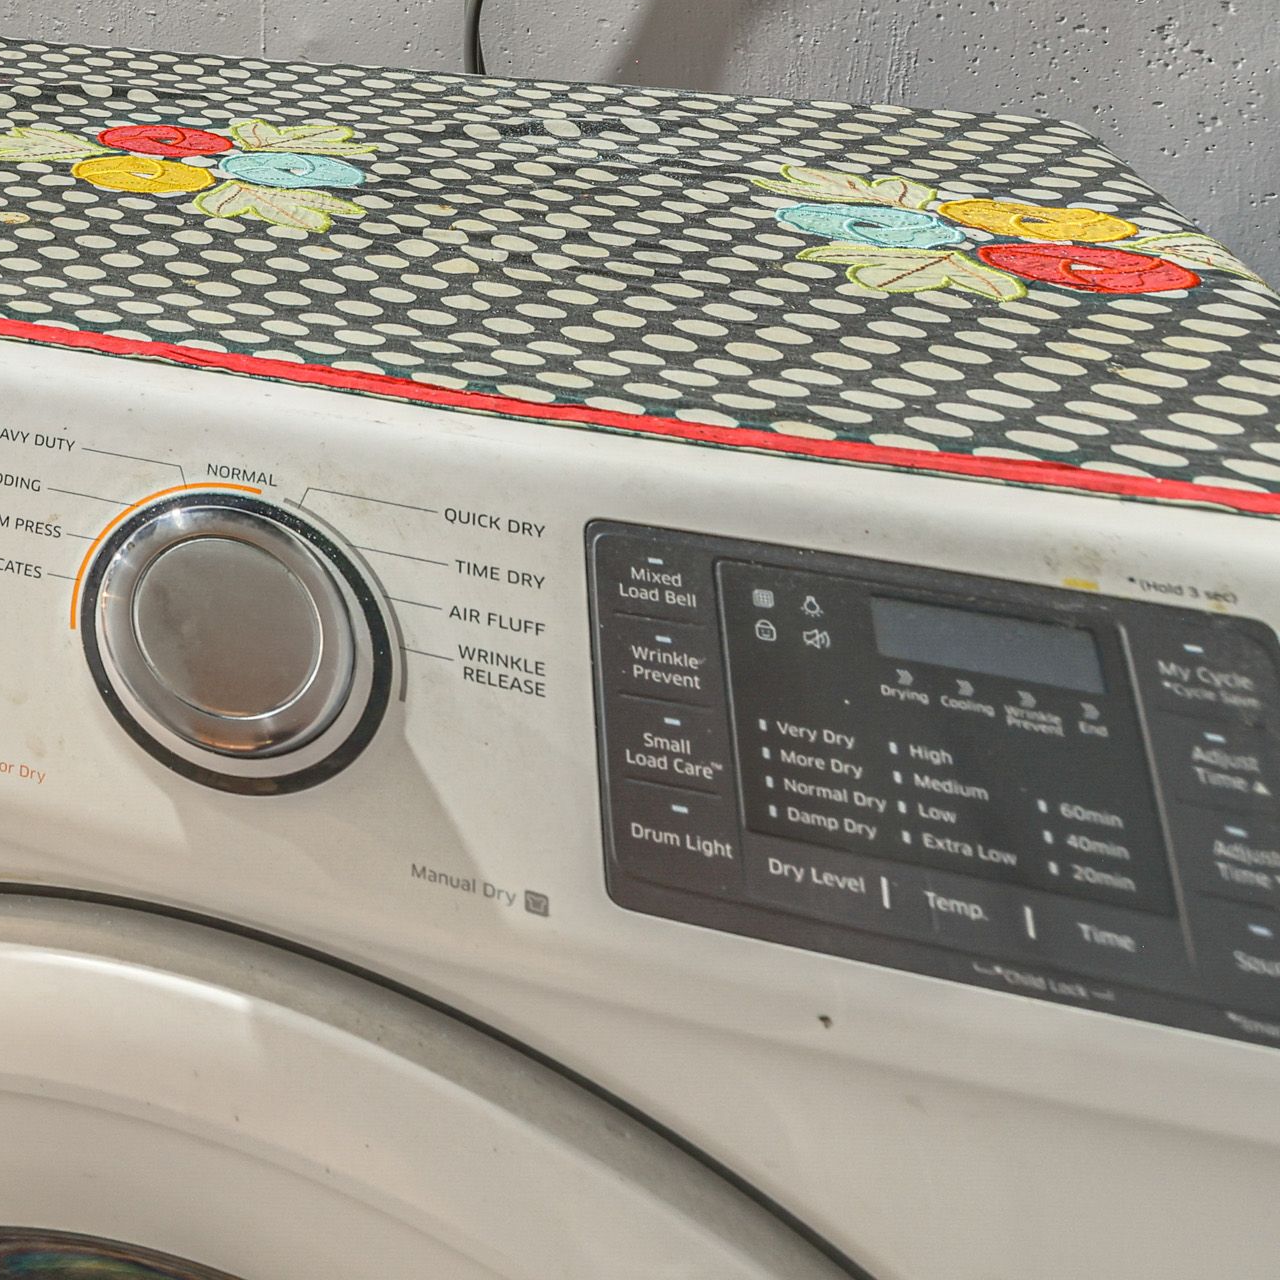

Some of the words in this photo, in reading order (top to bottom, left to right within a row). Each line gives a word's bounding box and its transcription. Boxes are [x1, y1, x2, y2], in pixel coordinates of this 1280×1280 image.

[34, 433, 76, 453] DUTY
[206, 463, 278, 488] NORMAL
[14, 517, 62, 539] PRESS
[444, 507, 501, 531] QUICK
[508, 519, 545, 538] DRY
[455, 559, 500, 581] TIME
[507, 570, 545, 590] DRY
[630, 566, 682, 588] Mixed
[619, 583, 659, 602] Load
[665, 590, 697, 608] Bell
[449, 605, 481, 624] AIR
[487, 612, 546, 637] FLUFF
[458, 644, 547, 677] WRINKLE
[632, 645, 699, 670] Wrinkle
[463, 666, 546, 699] RELEASE
[632, 665, 701, 691] Prevent
[880, 684, 930, 705] Drying
[940, 695, 995, 718] Cooling
[776, 720, 817, 743] Very
[823, 729, 855, 750] Dry
[1078, 720, 1109, 737] End
[643, 732, 691, 756] Small
[909, 743, 953, 766] High
[19, 764, 46, 784] Dry
[625, 749, 668, 771] Load
[780, 749, 825, 770] More
[830, 758, 863, 779] Dry
[783, 777, 849, 803] Normal
[853, 791, 887, 813] Dry
[913, 773, 989, 801] Medium
[787, 807, 839, 831] Damp
[843, 818, 877, 840] Dry
[918, 803, 957, 823] Low
[1060, 802, 1124, 829] 60min
[630, 822, 681, 847] Drum
[685, 832, 734, 860] Light
[922, 833, 973, 857] Extra
[977, 844, 1017, 866] Low
[411, 863, 476, 894] Manual
[483, 882, 516, 907] Dry
[768, 857, 804, 882] Dry
[811, 867, 865, 893] Level
[1077, 922, 1136, 952] Time
